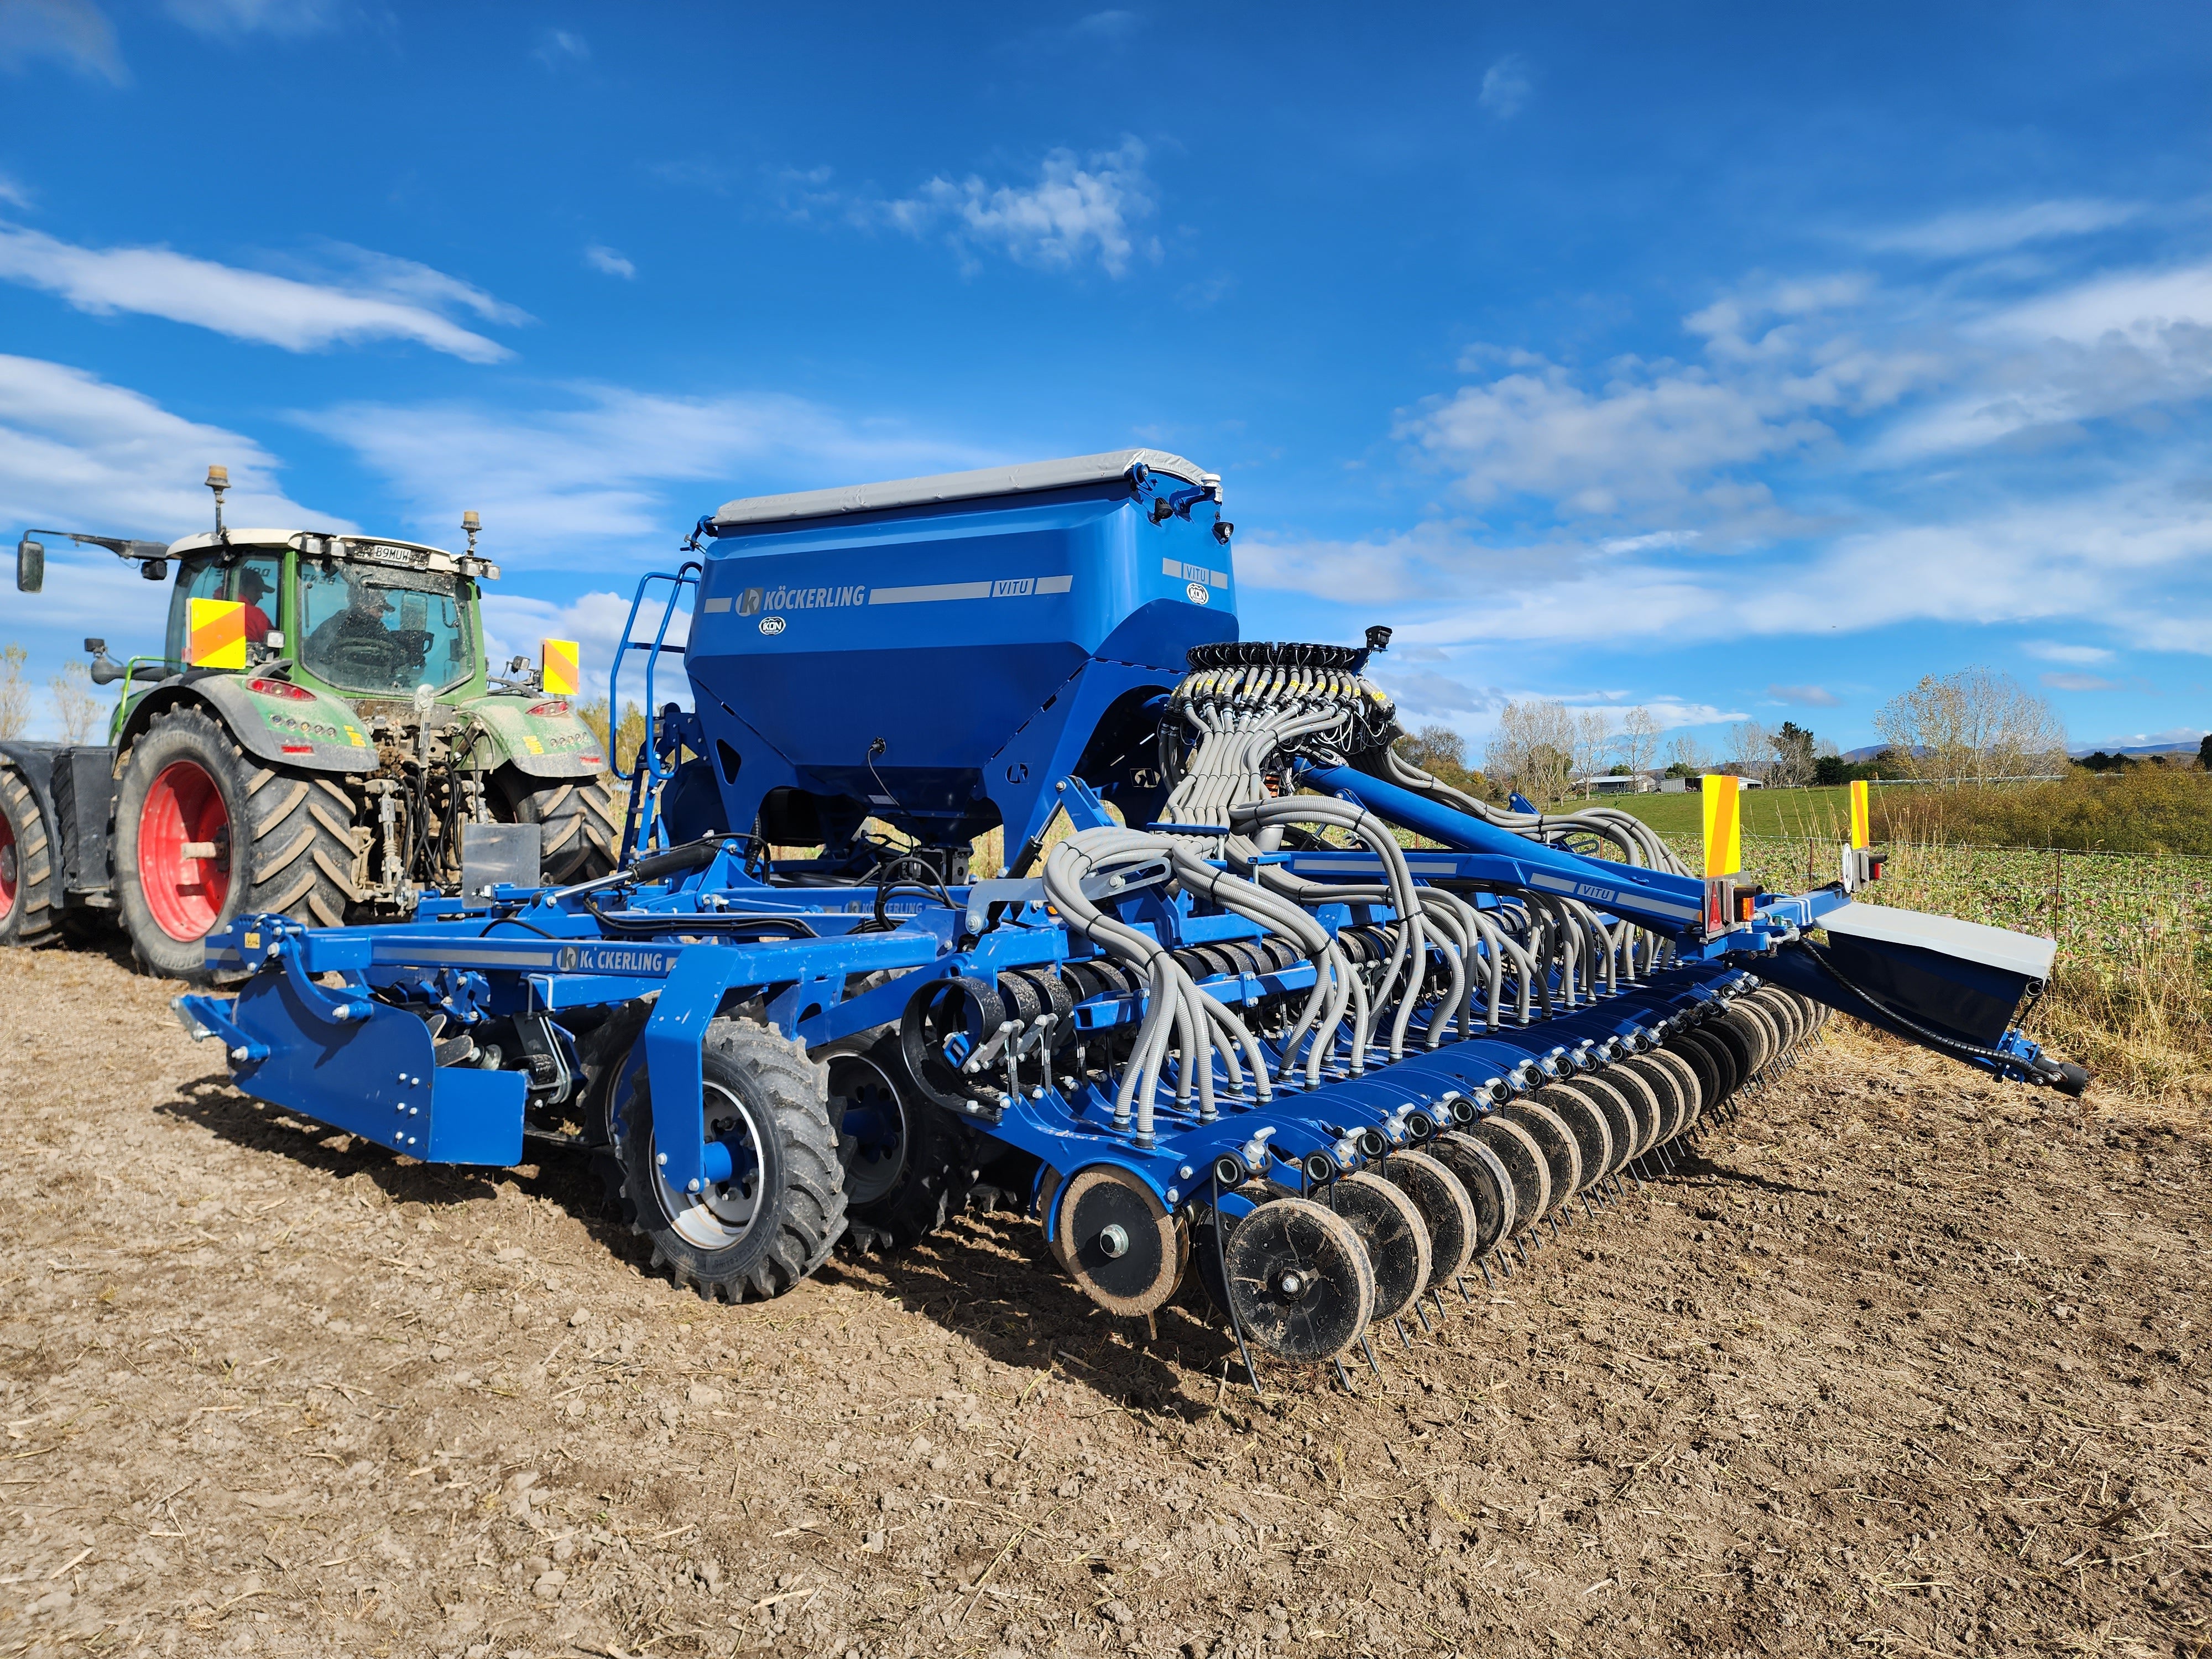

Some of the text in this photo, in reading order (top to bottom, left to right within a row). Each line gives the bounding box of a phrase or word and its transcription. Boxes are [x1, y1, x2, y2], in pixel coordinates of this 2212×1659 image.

[1187, 566, 1206, 582] VITU
[764, 585, 865, 611] KÖCKERLING
[999, 580, 1029, 595] VITU
[1584, 885, 1610, 899] VITU
